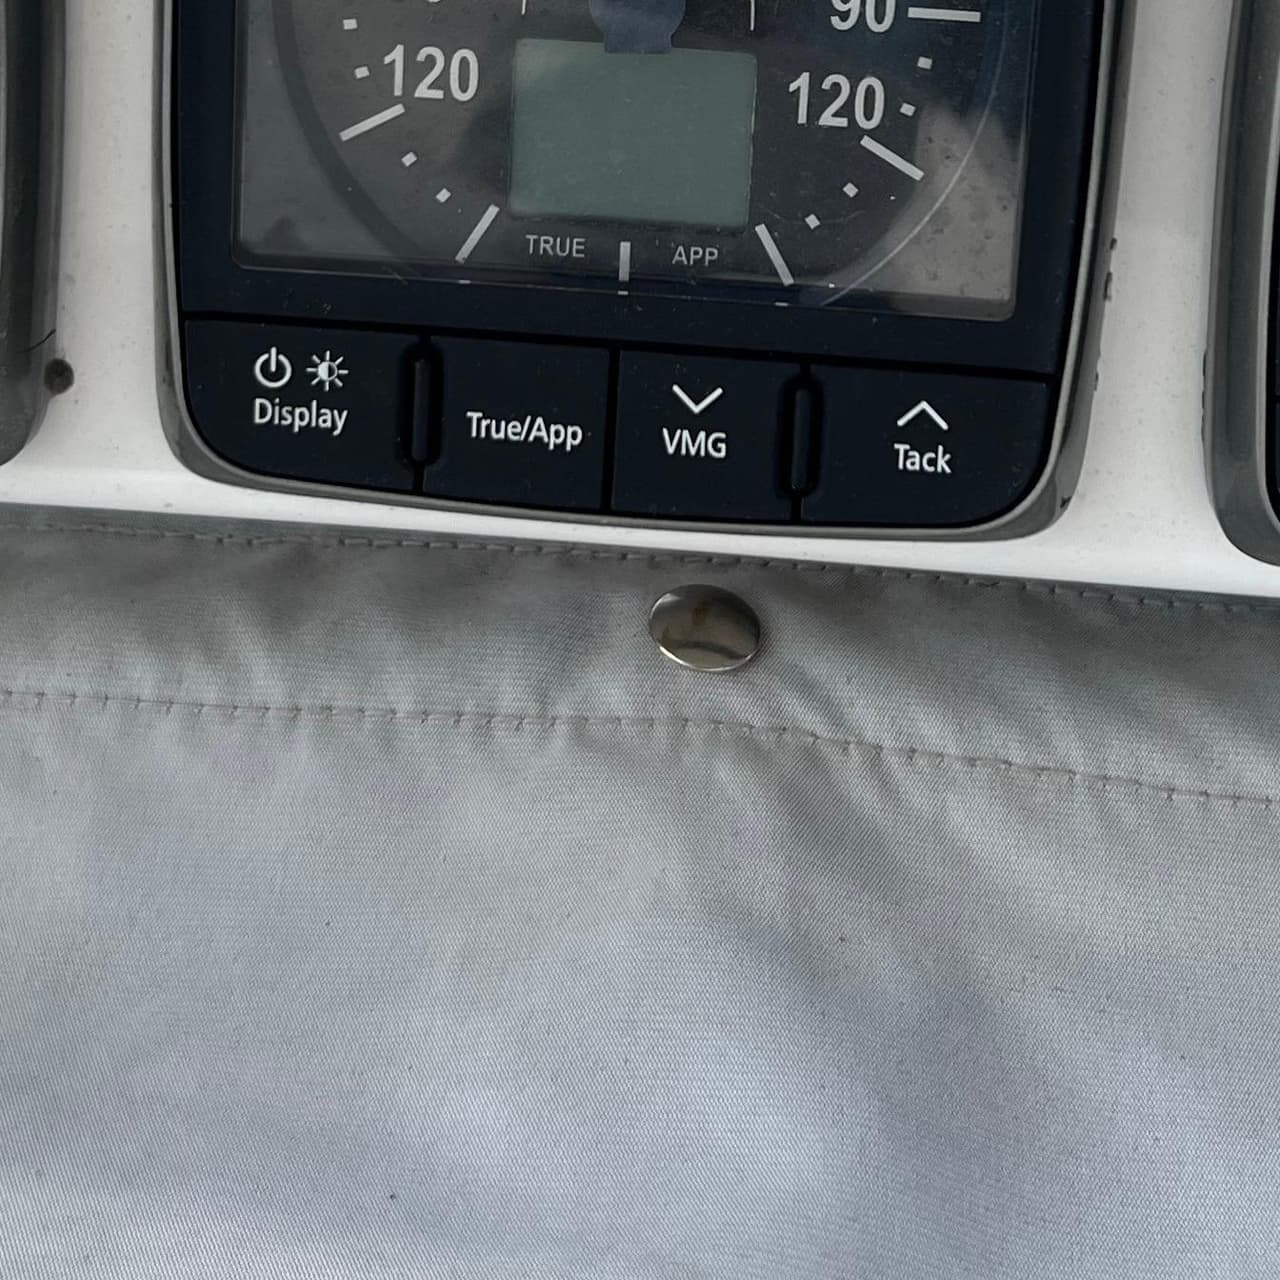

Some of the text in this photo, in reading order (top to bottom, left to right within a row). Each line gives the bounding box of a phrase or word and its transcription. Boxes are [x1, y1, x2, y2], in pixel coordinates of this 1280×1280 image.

[383, 44, 479, 102] 120
[788, 71, 885, 130] 120
[525, 234, 586, 258] TRUE
[672, 245, 719, 266] APP
[254, 397, 348, 436] Display
[466, 411, 583, 452] True/App
[662, 427, 727, 458] VMG
[893, 443, 952, 474] Tack
